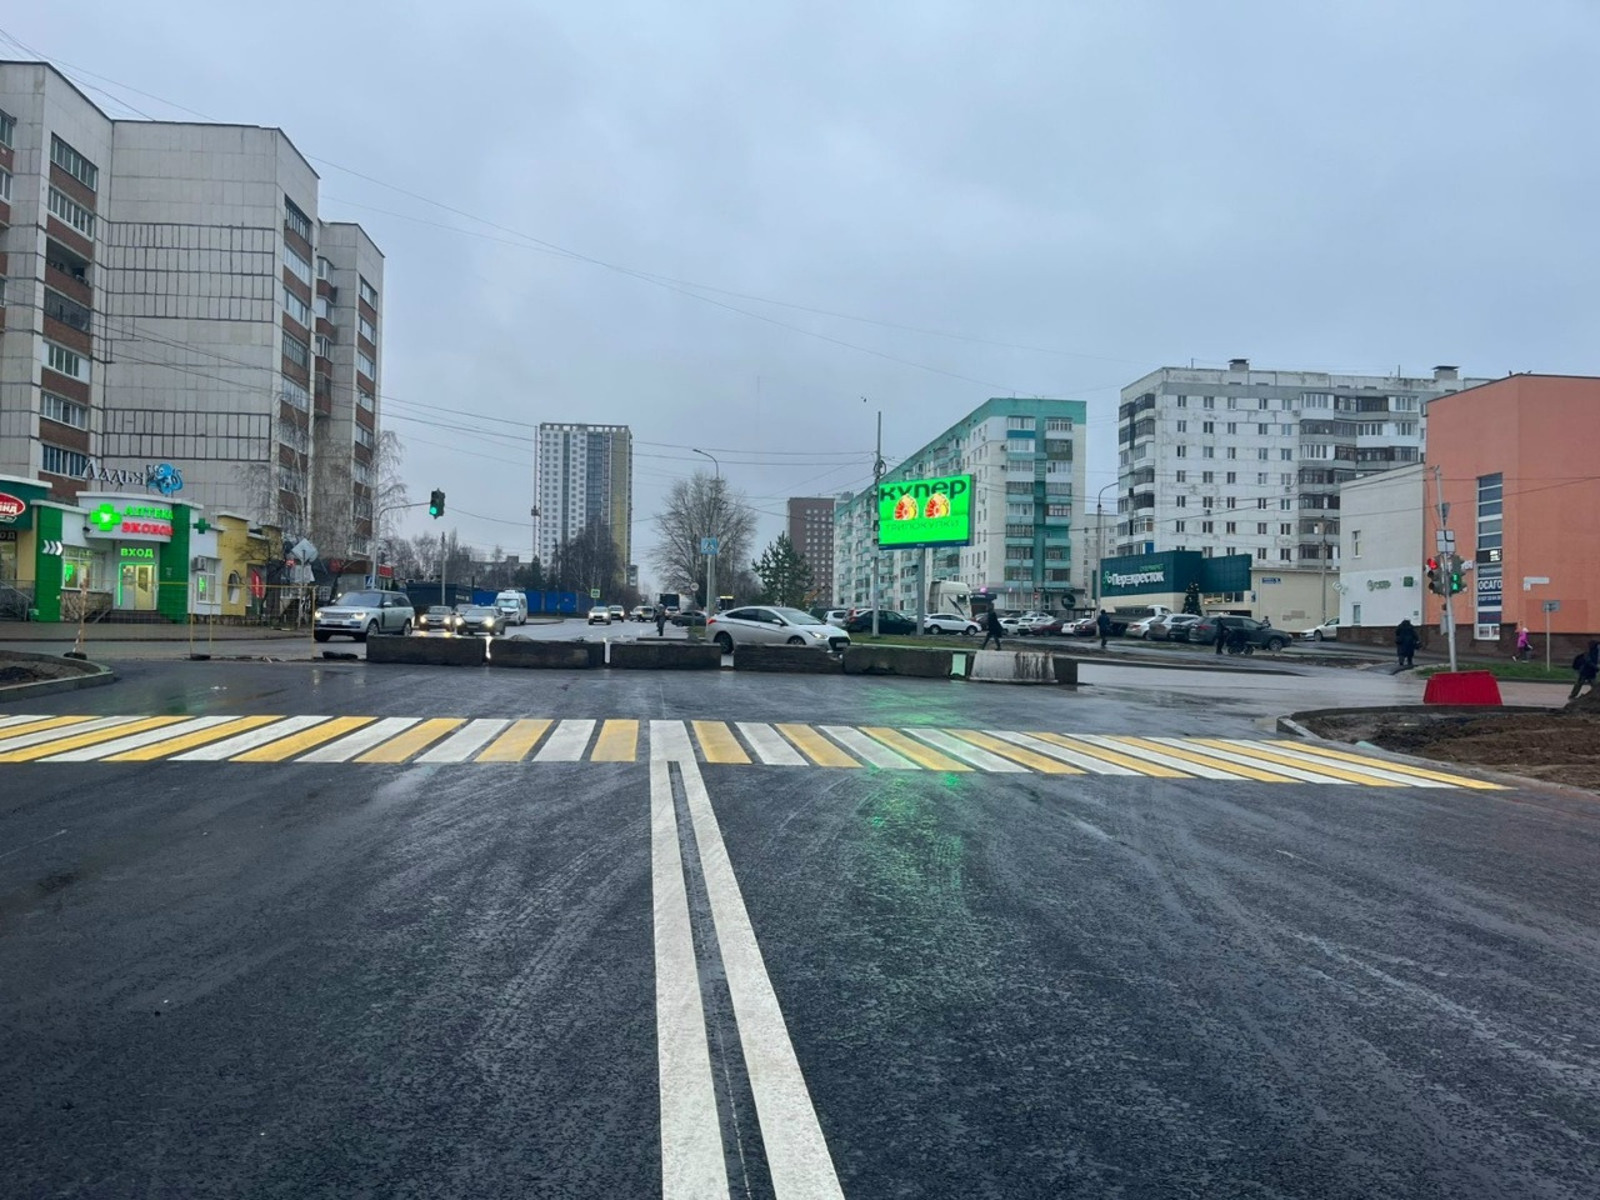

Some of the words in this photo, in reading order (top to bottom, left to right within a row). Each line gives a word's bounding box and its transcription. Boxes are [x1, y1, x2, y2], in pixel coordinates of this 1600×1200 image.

[880, 480, 967, 501] купер
[124, 506, 173, 520] АПТЕКА
[121, 521, 174, 536] ЭКОНОМ
[1478, 579, 1502, 591] ОСАГО
